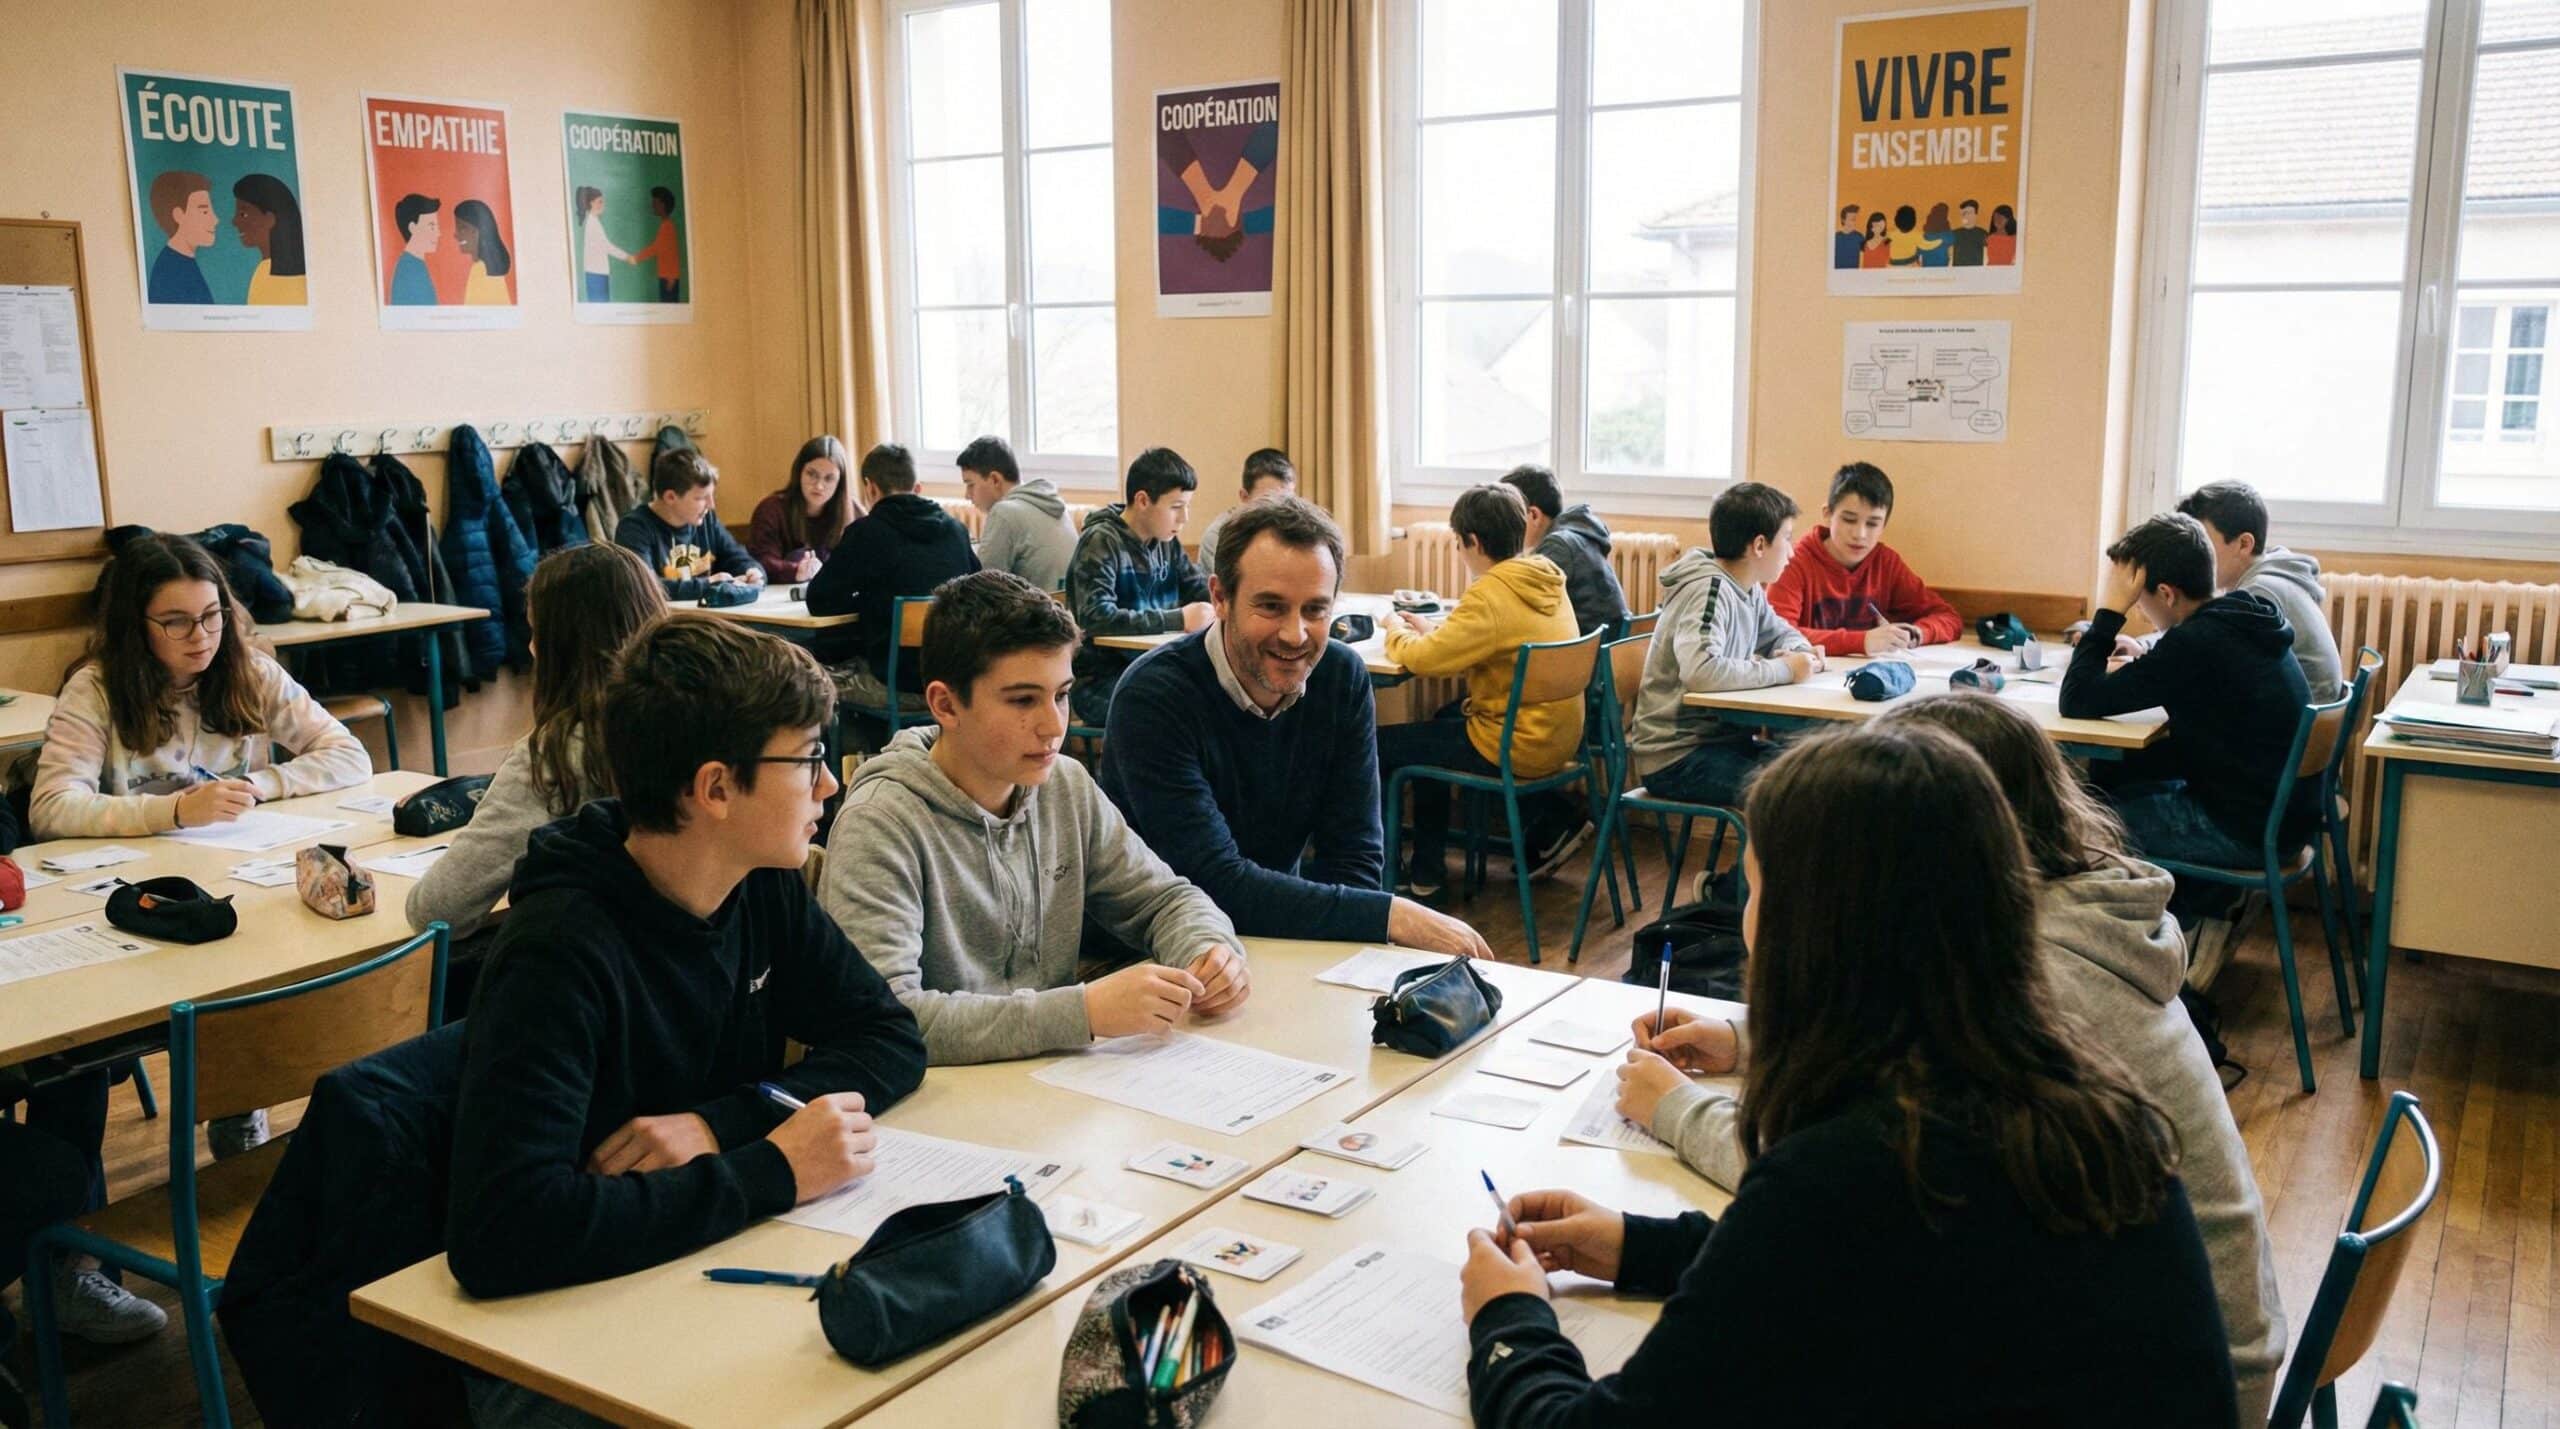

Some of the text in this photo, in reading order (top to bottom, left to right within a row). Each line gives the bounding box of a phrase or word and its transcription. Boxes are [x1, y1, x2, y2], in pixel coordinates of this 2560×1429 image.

[1855, 47, 2011, 122] VIVRE
[137, 82, 286, 151] ÉCOUTE
[375, 110, 502, 156] EMPATHIE
[1161, 95, 1278, 132] COOPÉRATION
[568, 121, 680, 158] COOPÉRATION
[1851, 124, 2009, 169] ENSEMBLE
